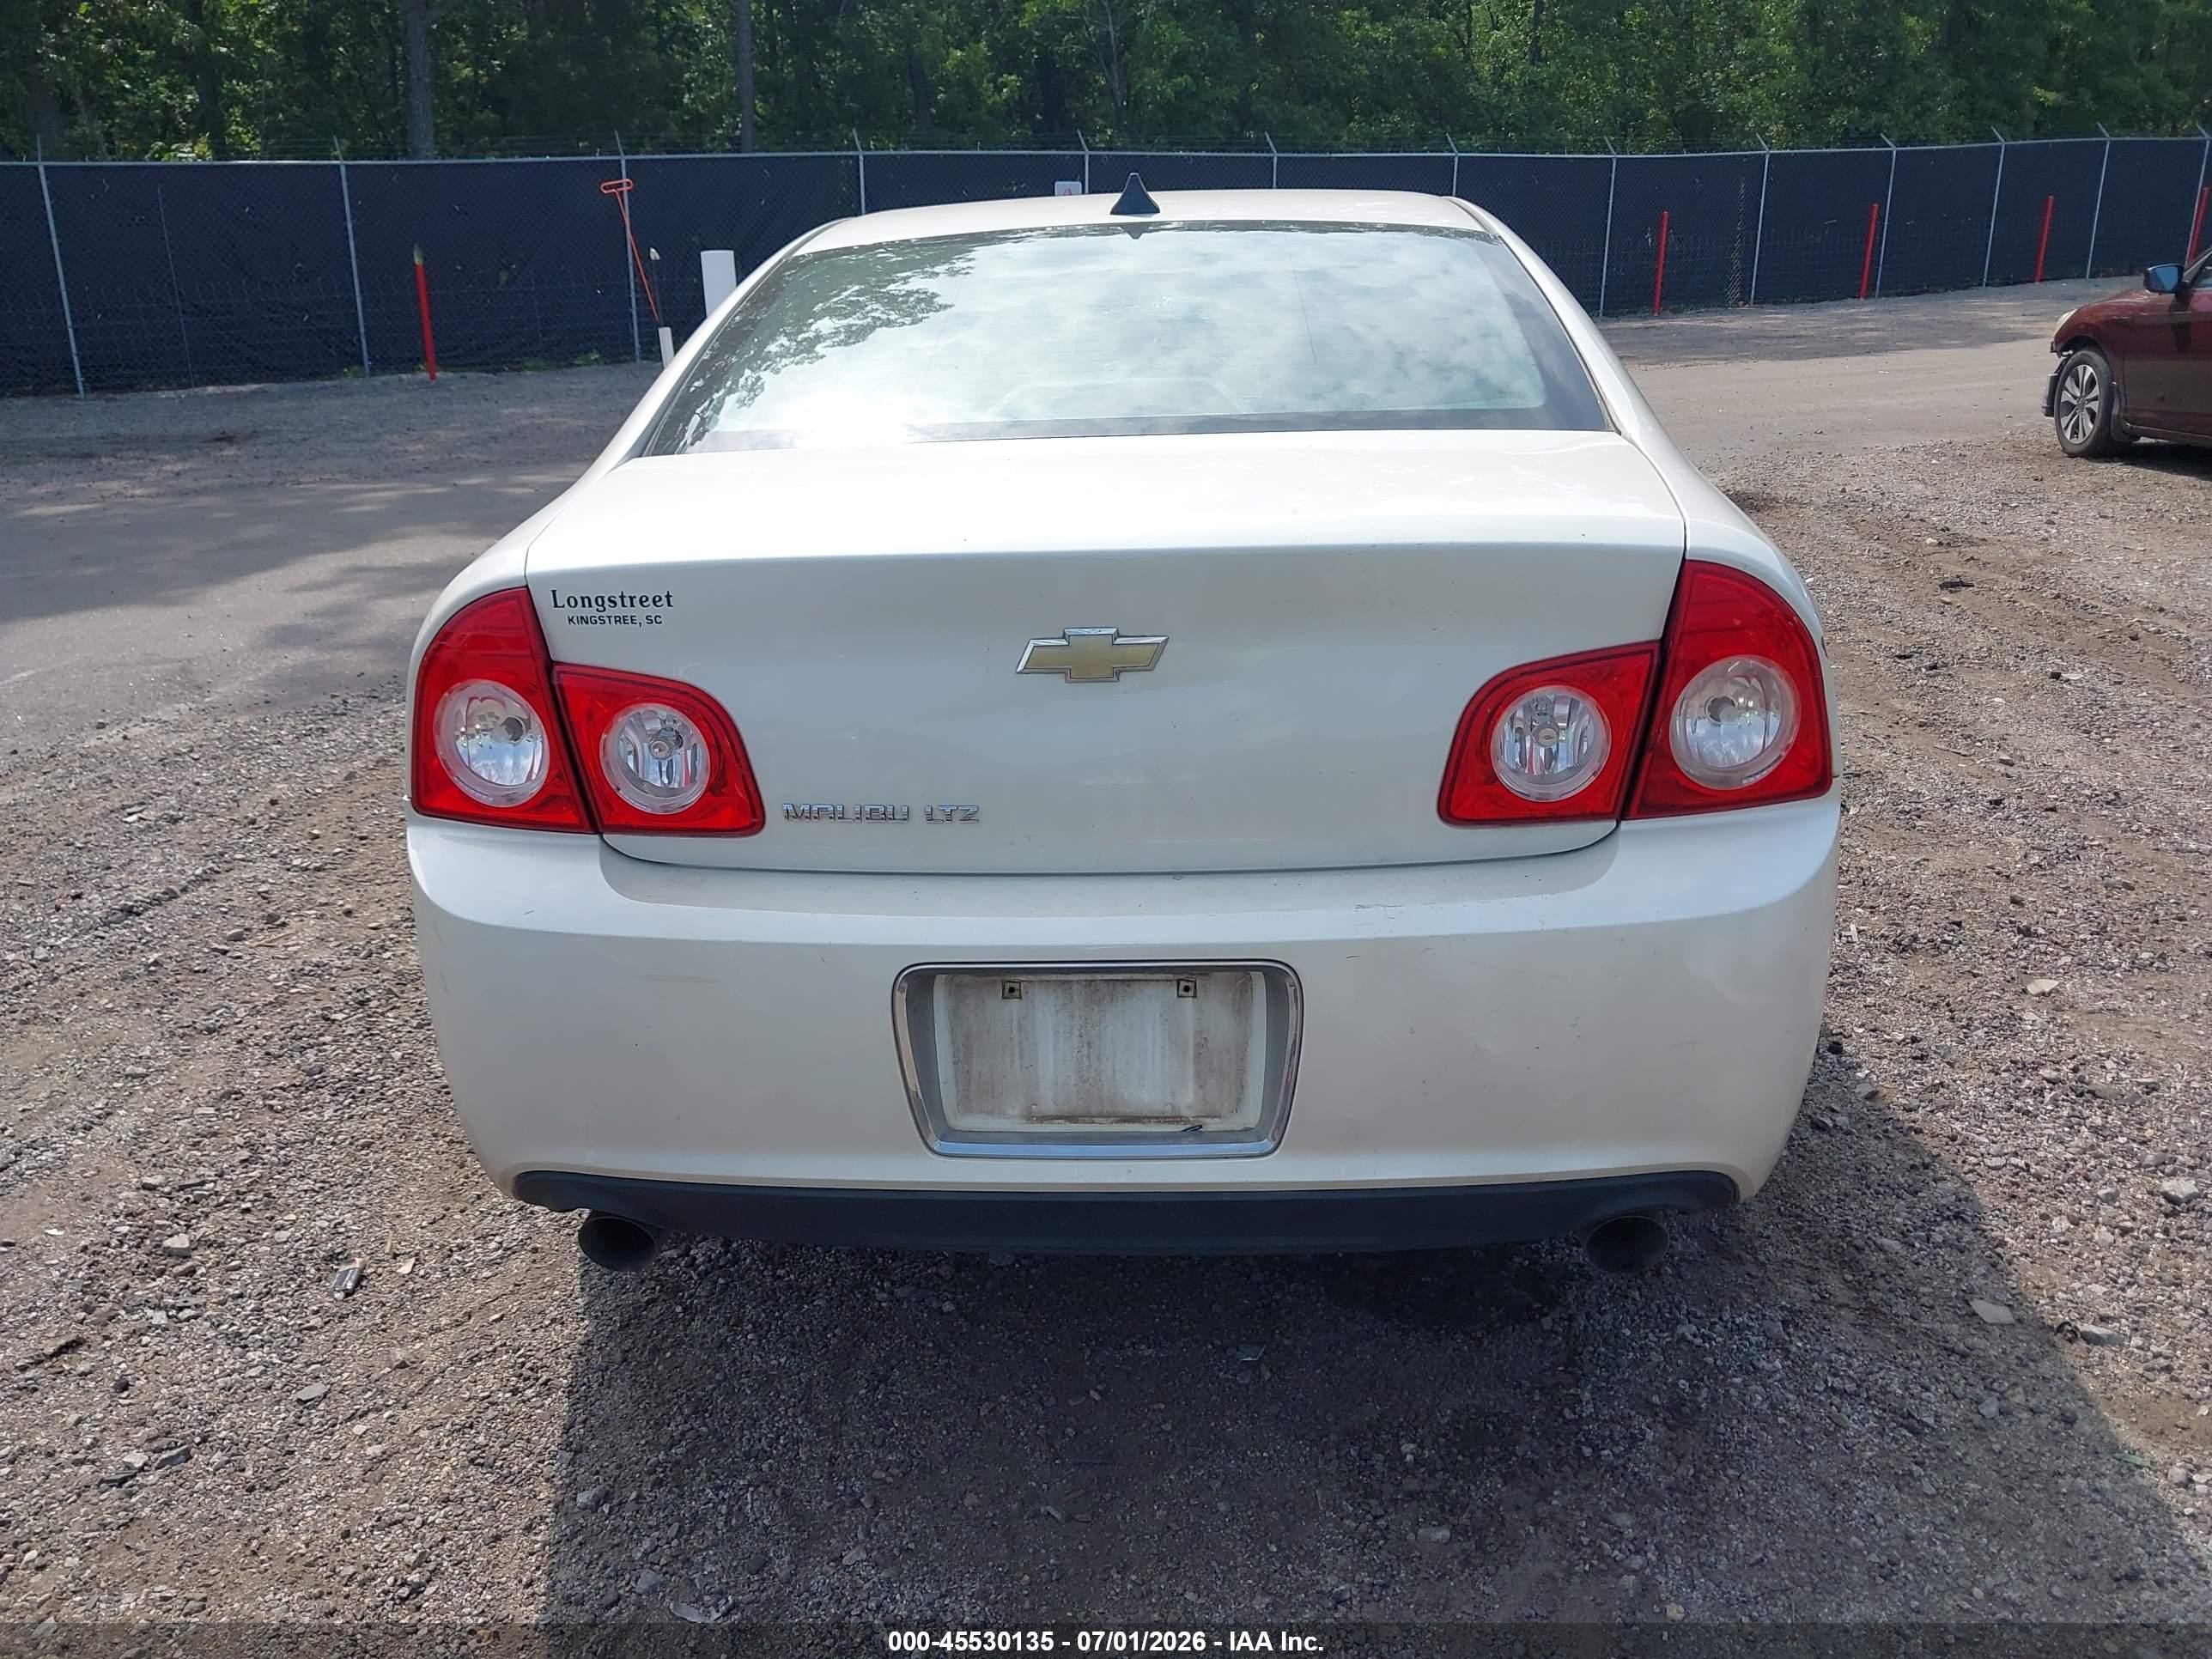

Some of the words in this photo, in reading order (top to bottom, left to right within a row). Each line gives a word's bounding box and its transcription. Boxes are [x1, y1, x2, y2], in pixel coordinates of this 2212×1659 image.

[550, 589, 674, 613] Longstreet
[568, 615, 642, 628] KINGSTREE,
[647, 615, 663, 625] SC
[782, 803, 909, 823] MALIBU
[926, 805, 980, 823] LTZ
